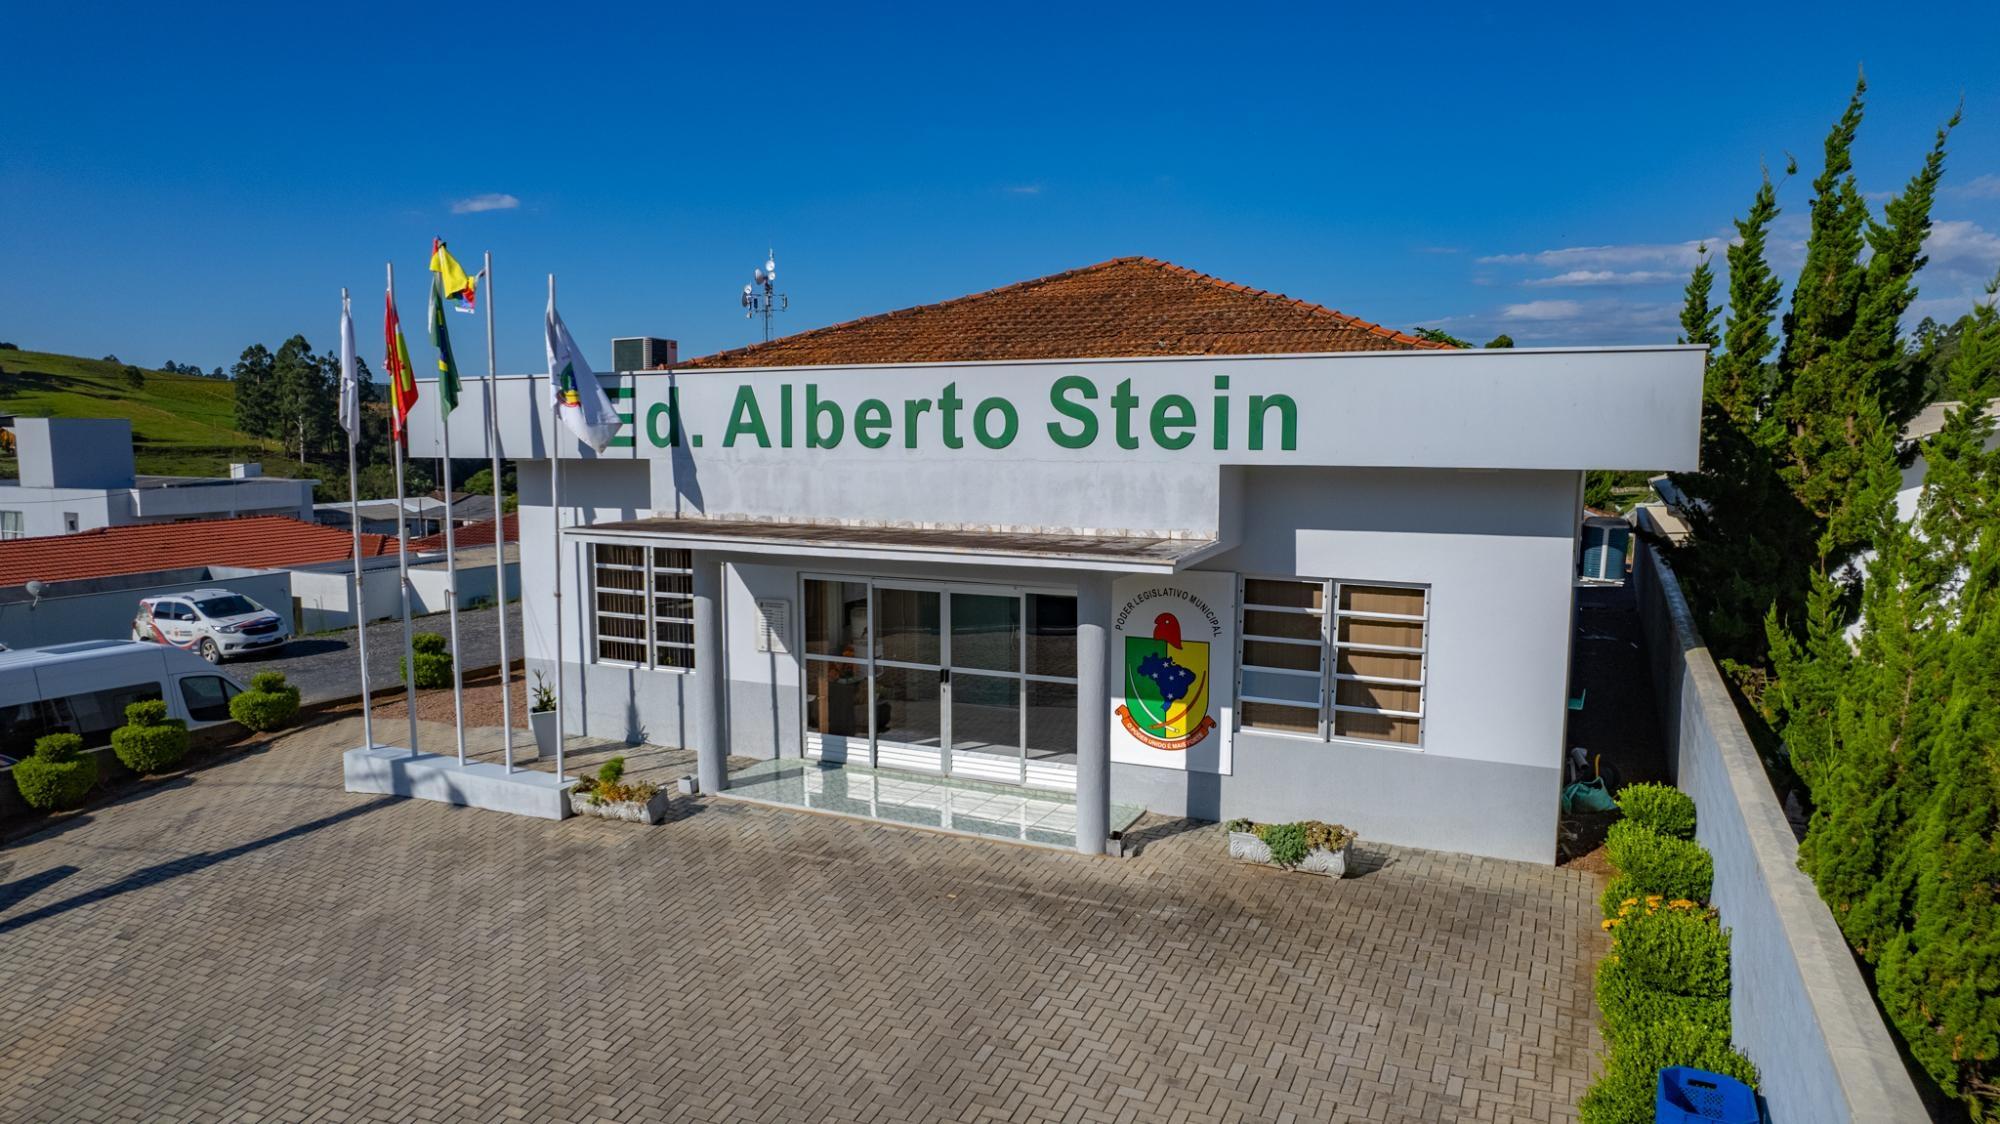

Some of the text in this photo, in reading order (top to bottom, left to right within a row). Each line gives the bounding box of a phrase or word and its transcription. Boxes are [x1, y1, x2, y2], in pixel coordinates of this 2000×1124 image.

[725, 383, 1018, 449] Alberto
[1047, 375, 1297, 450] Stein
[1115, 588, 1222, 637] PODER LEGISLATIVO MUNICIPAL
